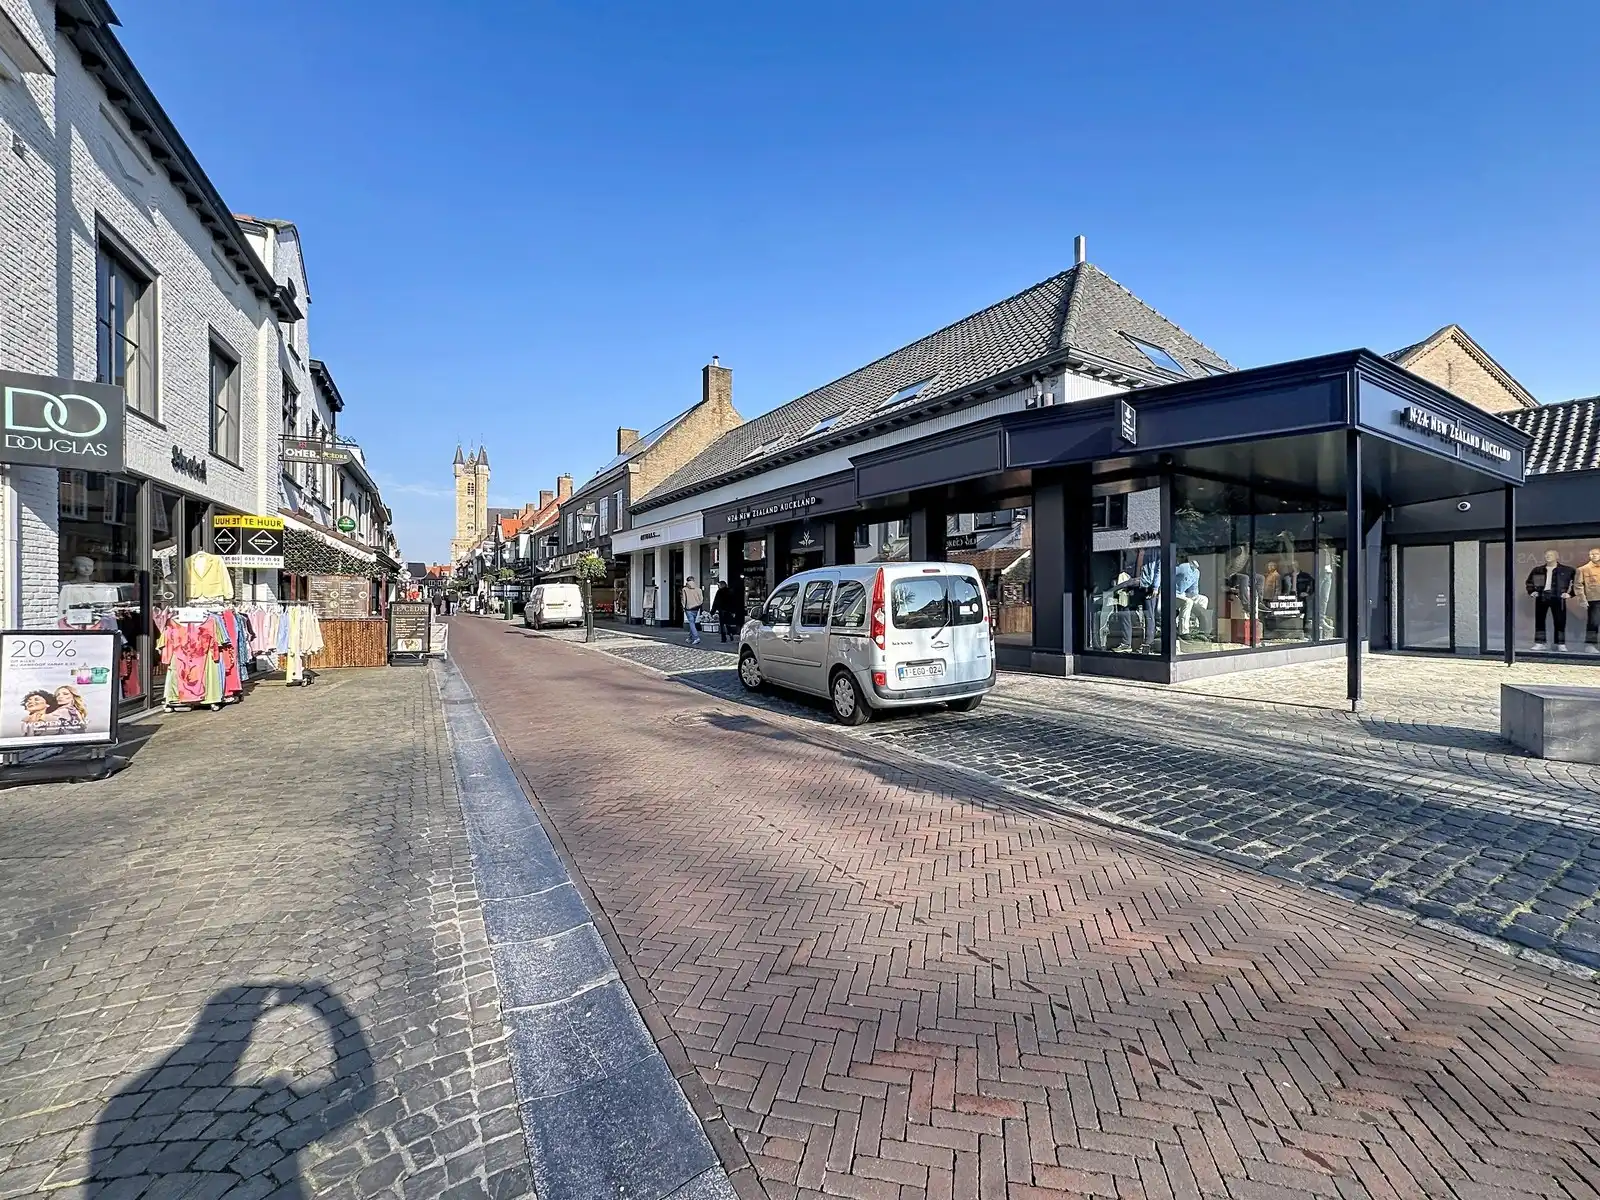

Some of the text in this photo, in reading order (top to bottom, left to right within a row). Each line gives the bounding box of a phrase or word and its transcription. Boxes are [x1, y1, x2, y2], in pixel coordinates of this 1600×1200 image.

[5, 434, 108, 457] DOUGLAS
[1430, 415, 1448, 436] NEW
[1449, 423, 1480, 449] ZEALAND
[1481, 437, 1511, 462] AUCKLAND
[752, 505, 779, 518] ZEALAND
[780, 496, 816, 511] AUCKLAND
[244, 518, 282, 527] TE HUUR
[11, 639, 45, 658] 20
[25, 719, 70, 727] WOMEN'S
